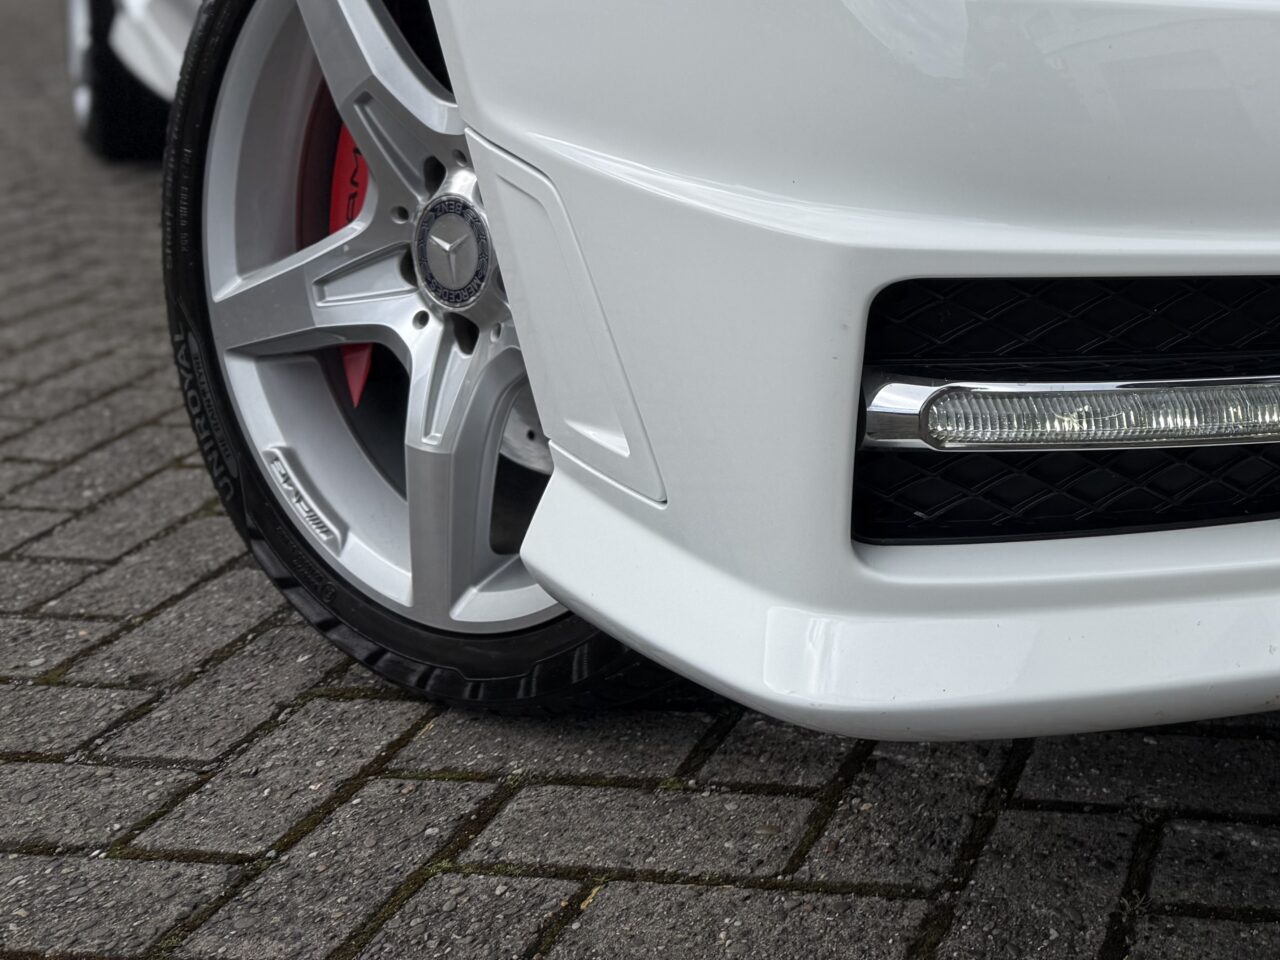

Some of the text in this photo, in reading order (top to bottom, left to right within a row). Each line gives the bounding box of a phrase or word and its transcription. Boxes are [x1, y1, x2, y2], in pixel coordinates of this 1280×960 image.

[434, 201, 463, 216] BENZ
[429, 276, 482, 302] MERCEDES
[175, 321, 236, 502] UNIROYAL
